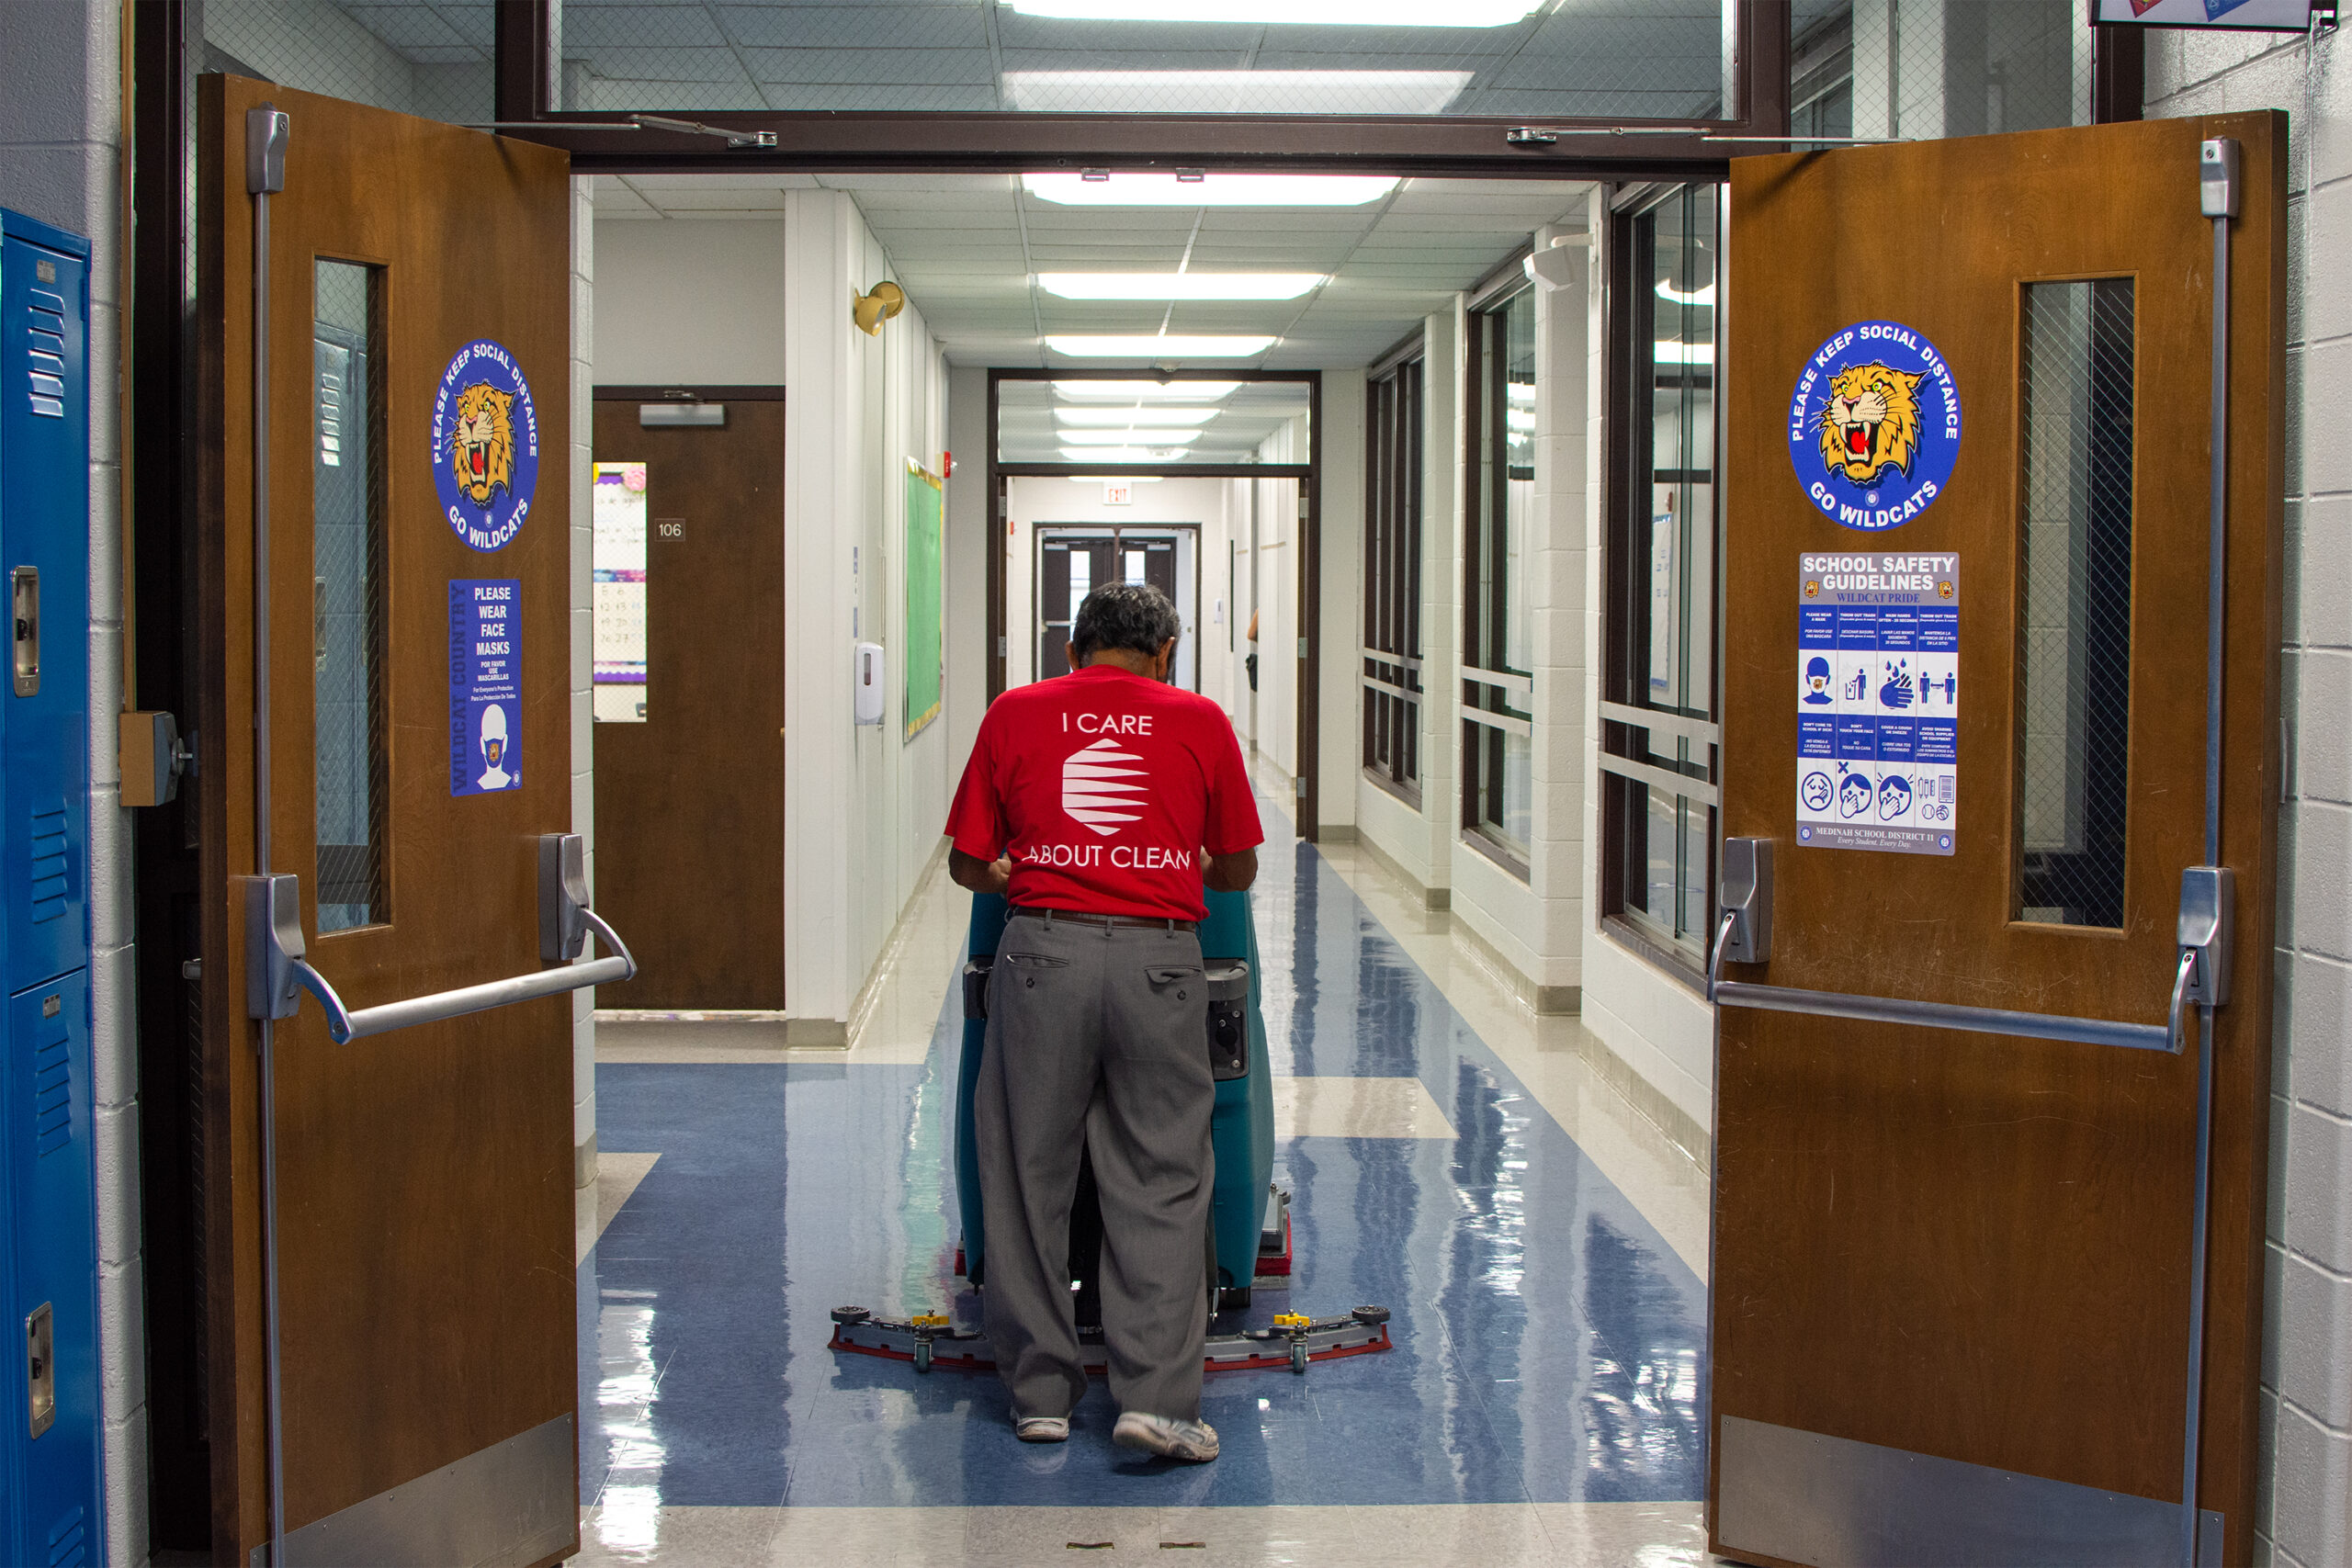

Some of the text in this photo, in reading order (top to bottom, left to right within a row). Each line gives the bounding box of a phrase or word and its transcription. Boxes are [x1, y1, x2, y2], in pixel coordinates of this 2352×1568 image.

[1792, 325, 1958, 441] PLEASE KEEP SOCIAL DISTANCE
[434, 344, 537, 464] PLEASE KEEP SOCIAL DISTANCE
[1109, 488, 1127, 503] EXIT
[1810, 481, 1836, 510] GO
[1839, 480, 1937, 527] WILDCATS
[448, 498, 528, 548] GO WILDCATS
[659, 523, 682, 536] 106
[1803, 557, 1955, 573] SCHOOL SAFETY
[1823, 575, 1934, 590] GUIDELINES
[475, 587, 511, 600] PLEASE
[1837, 593, 1920, 603] WILDCAT PRIDE
[479, 606, 507, 618] WEAR
[481, 624, 505, 637] FACE
[477, 642, 510, 655] MASKS
[451, 583, 467, 792] WILDCAT COUNTRY
[1062, 712, 1153, 735] I CARE
[1816, 827, 1853, 837] MEDINAH
[1854, 829, 1887, 838] SCHOOL
[1888, 831, 1925, 841] DISTRICT
[1838, 836, 1854, 845] Every
[1879, 839, 1897, 848] Every
[1021, 844, 1191, 870] ABOUT CLEAN
